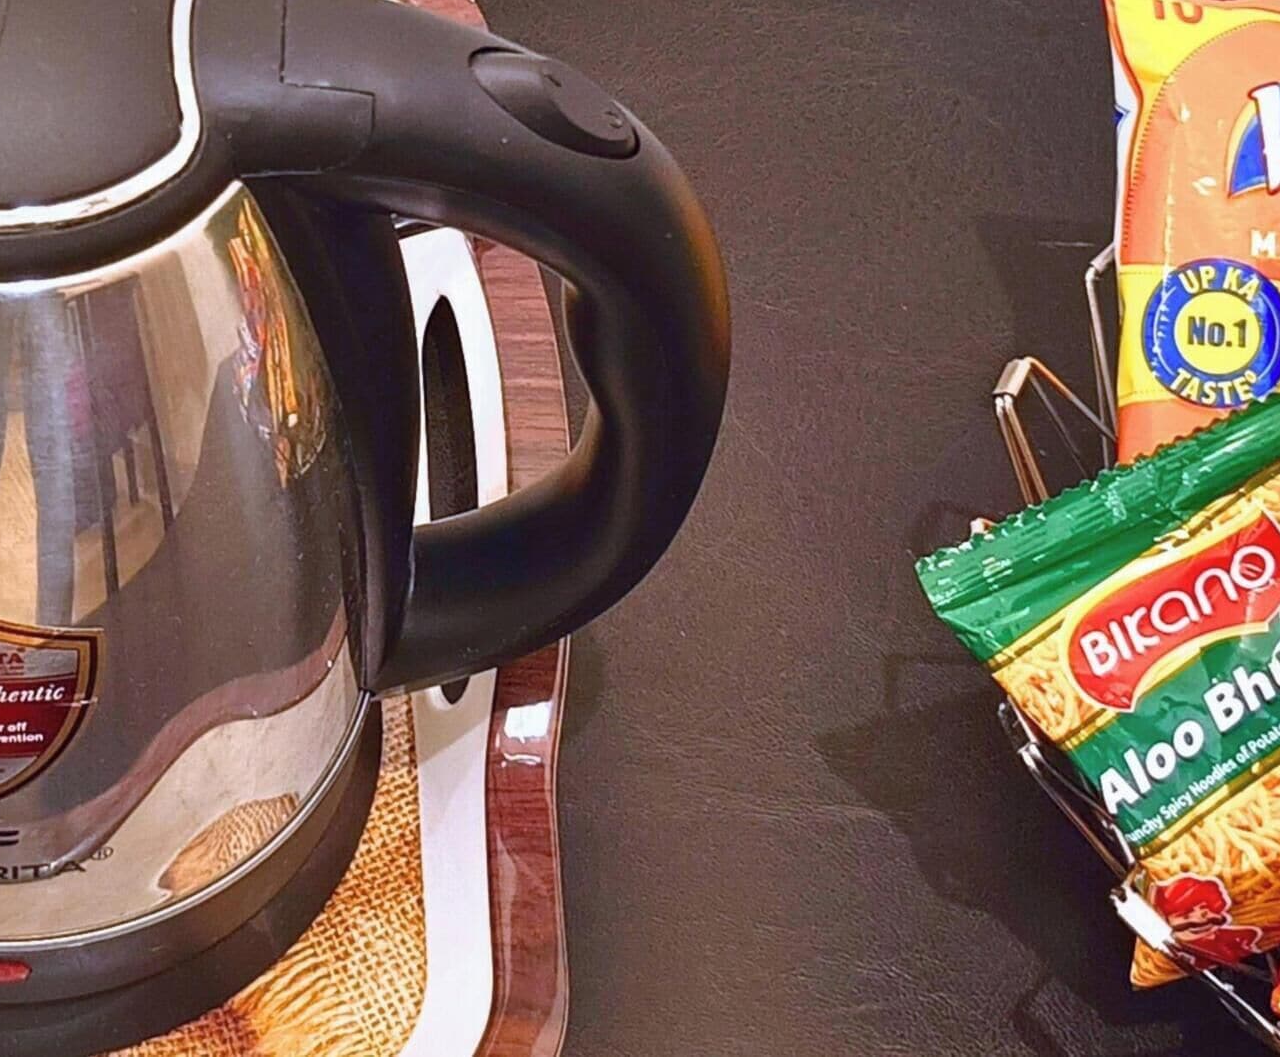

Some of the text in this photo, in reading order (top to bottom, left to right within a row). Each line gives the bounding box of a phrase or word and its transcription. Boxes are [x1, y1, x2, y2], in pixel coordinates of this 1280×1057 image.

[1177, 265, 1260, 302] UP KA
[1187, 316, 1247, 349] No.1
[7, 721, 28, 732] off
[1098, 717, 1206, 816] Aloo
[1124, 812, 1164, 845] unchy
[1160, 791, 1195, 827] Spicy
[1190, 754, 1237, 804] Noodles
[1234, 742, 1253, 766] of
